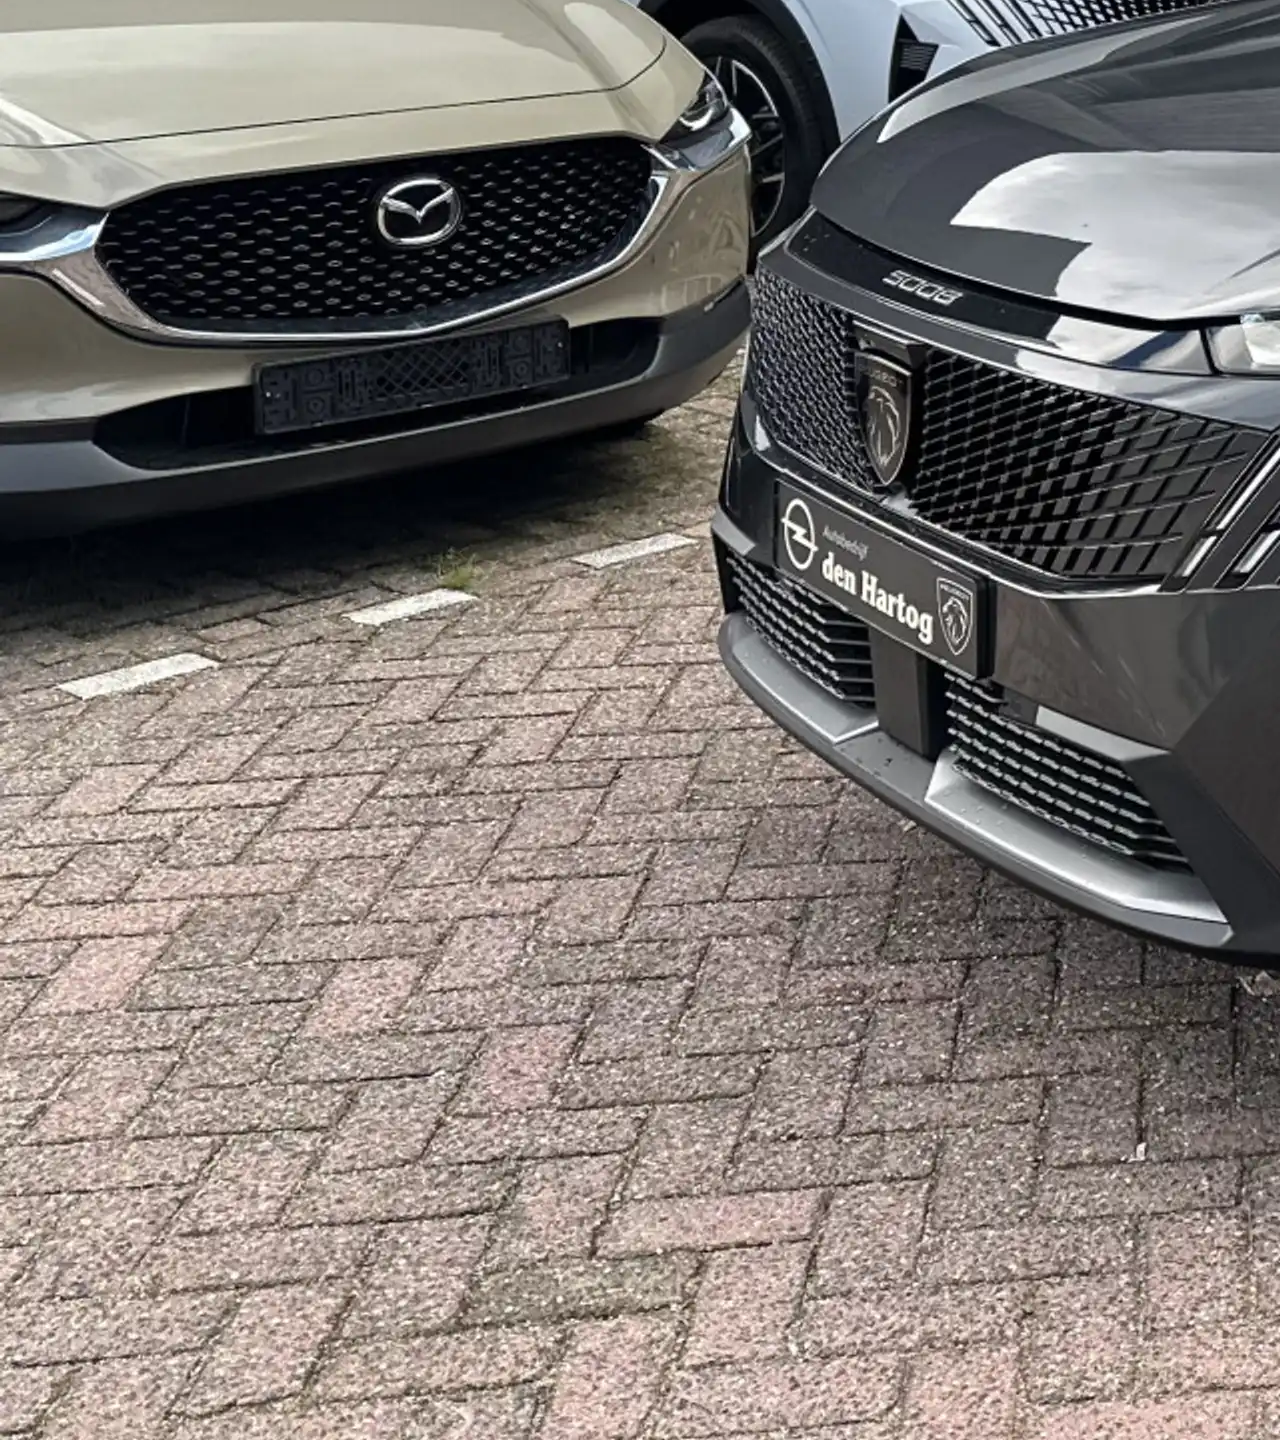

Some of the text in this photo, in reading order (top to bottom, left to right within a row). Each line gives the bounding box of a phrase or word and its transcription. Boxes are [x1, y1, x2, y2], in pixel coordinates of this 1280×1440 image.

[882, 270, 963, 306] 5008
[822, 552, 933, 645] den Hartog
